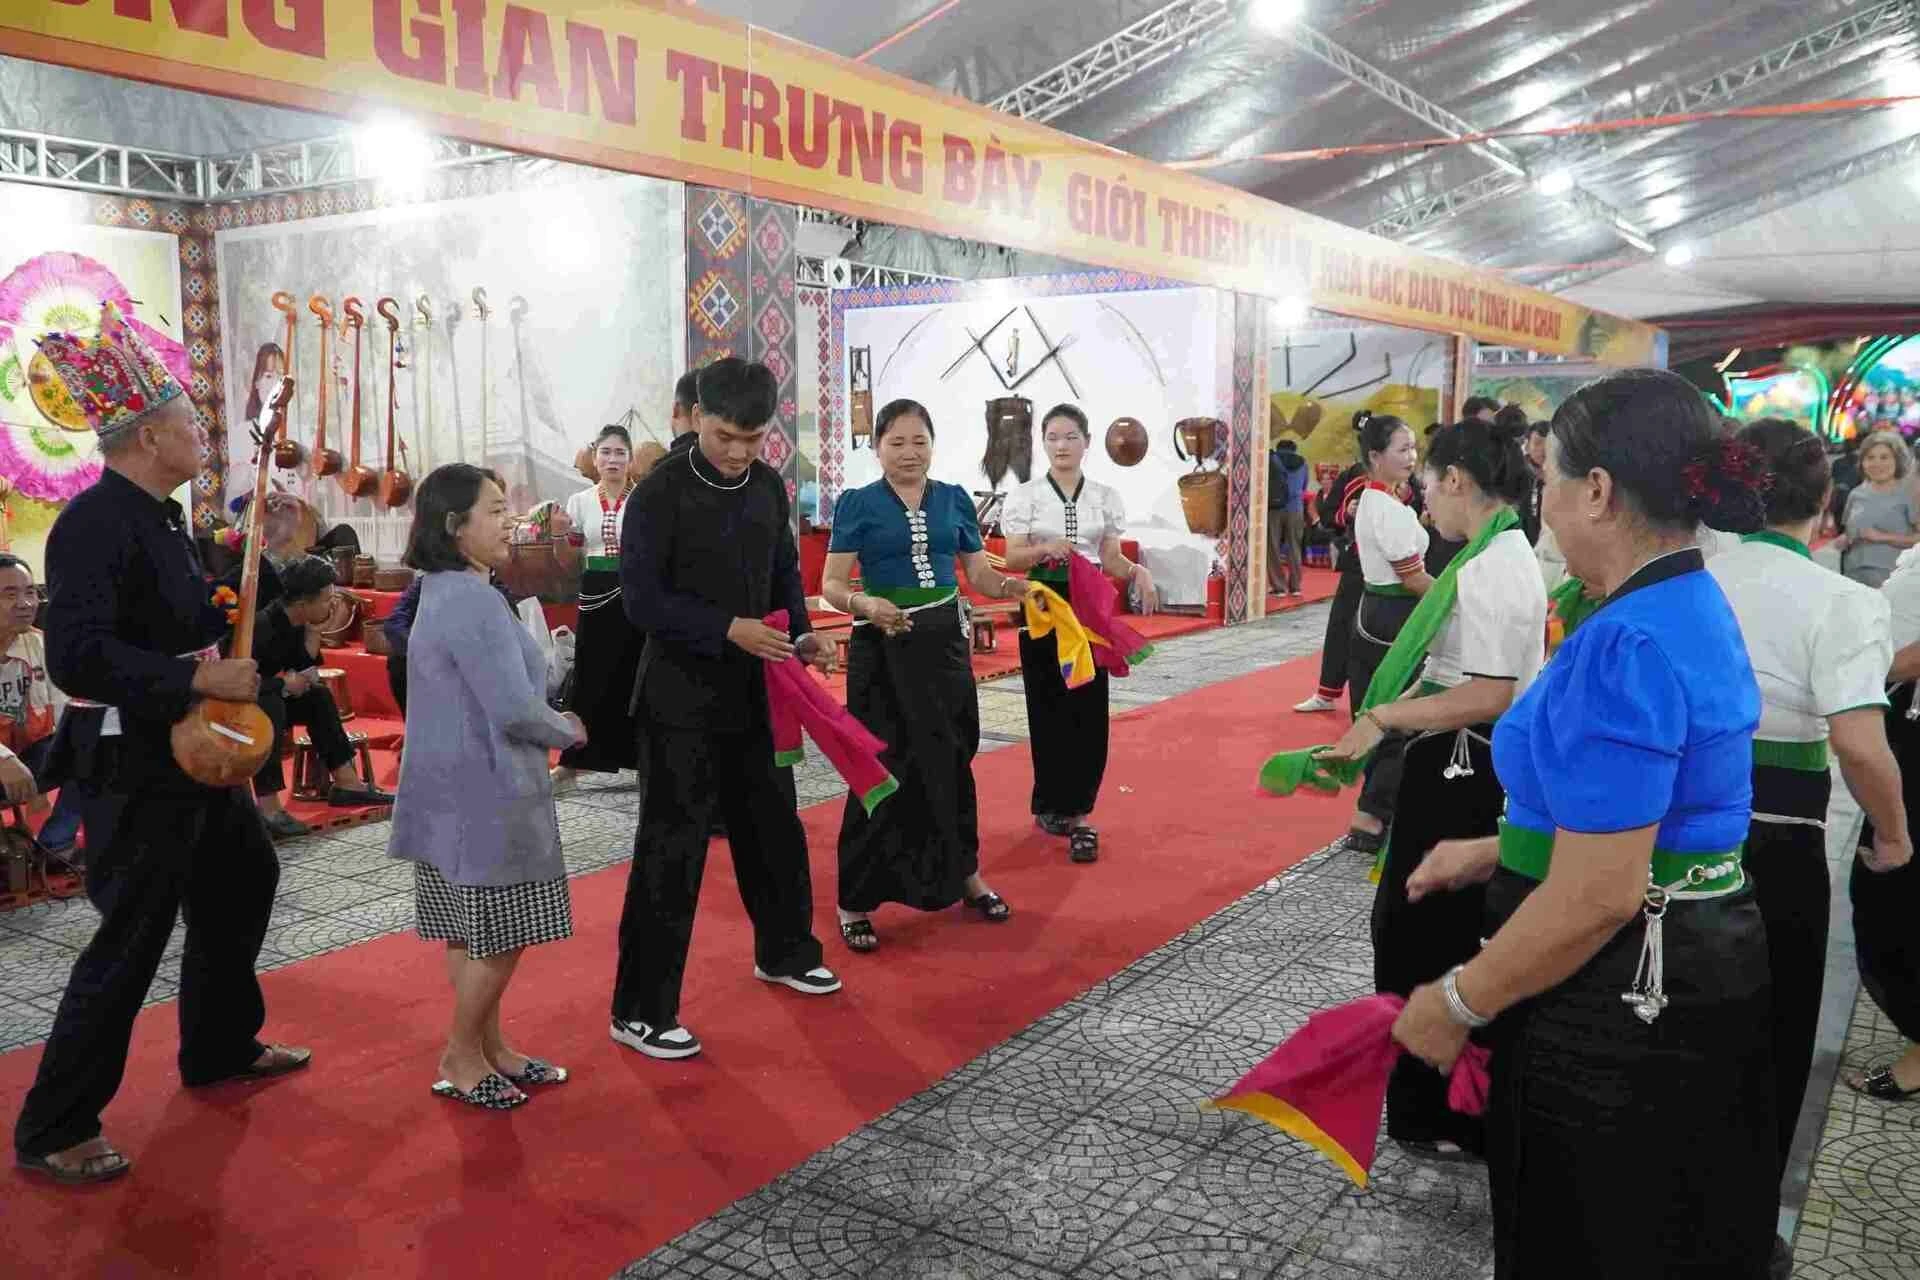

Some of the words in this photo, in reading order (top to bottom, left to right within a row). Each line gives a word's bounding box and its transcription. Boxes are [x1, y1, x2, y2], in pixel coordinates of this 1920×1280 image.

[373, 0, 640, 127] GIAN
[665, 48, 924, 194] TRƯNG
[943, 132, 1043, 220] BÀY
